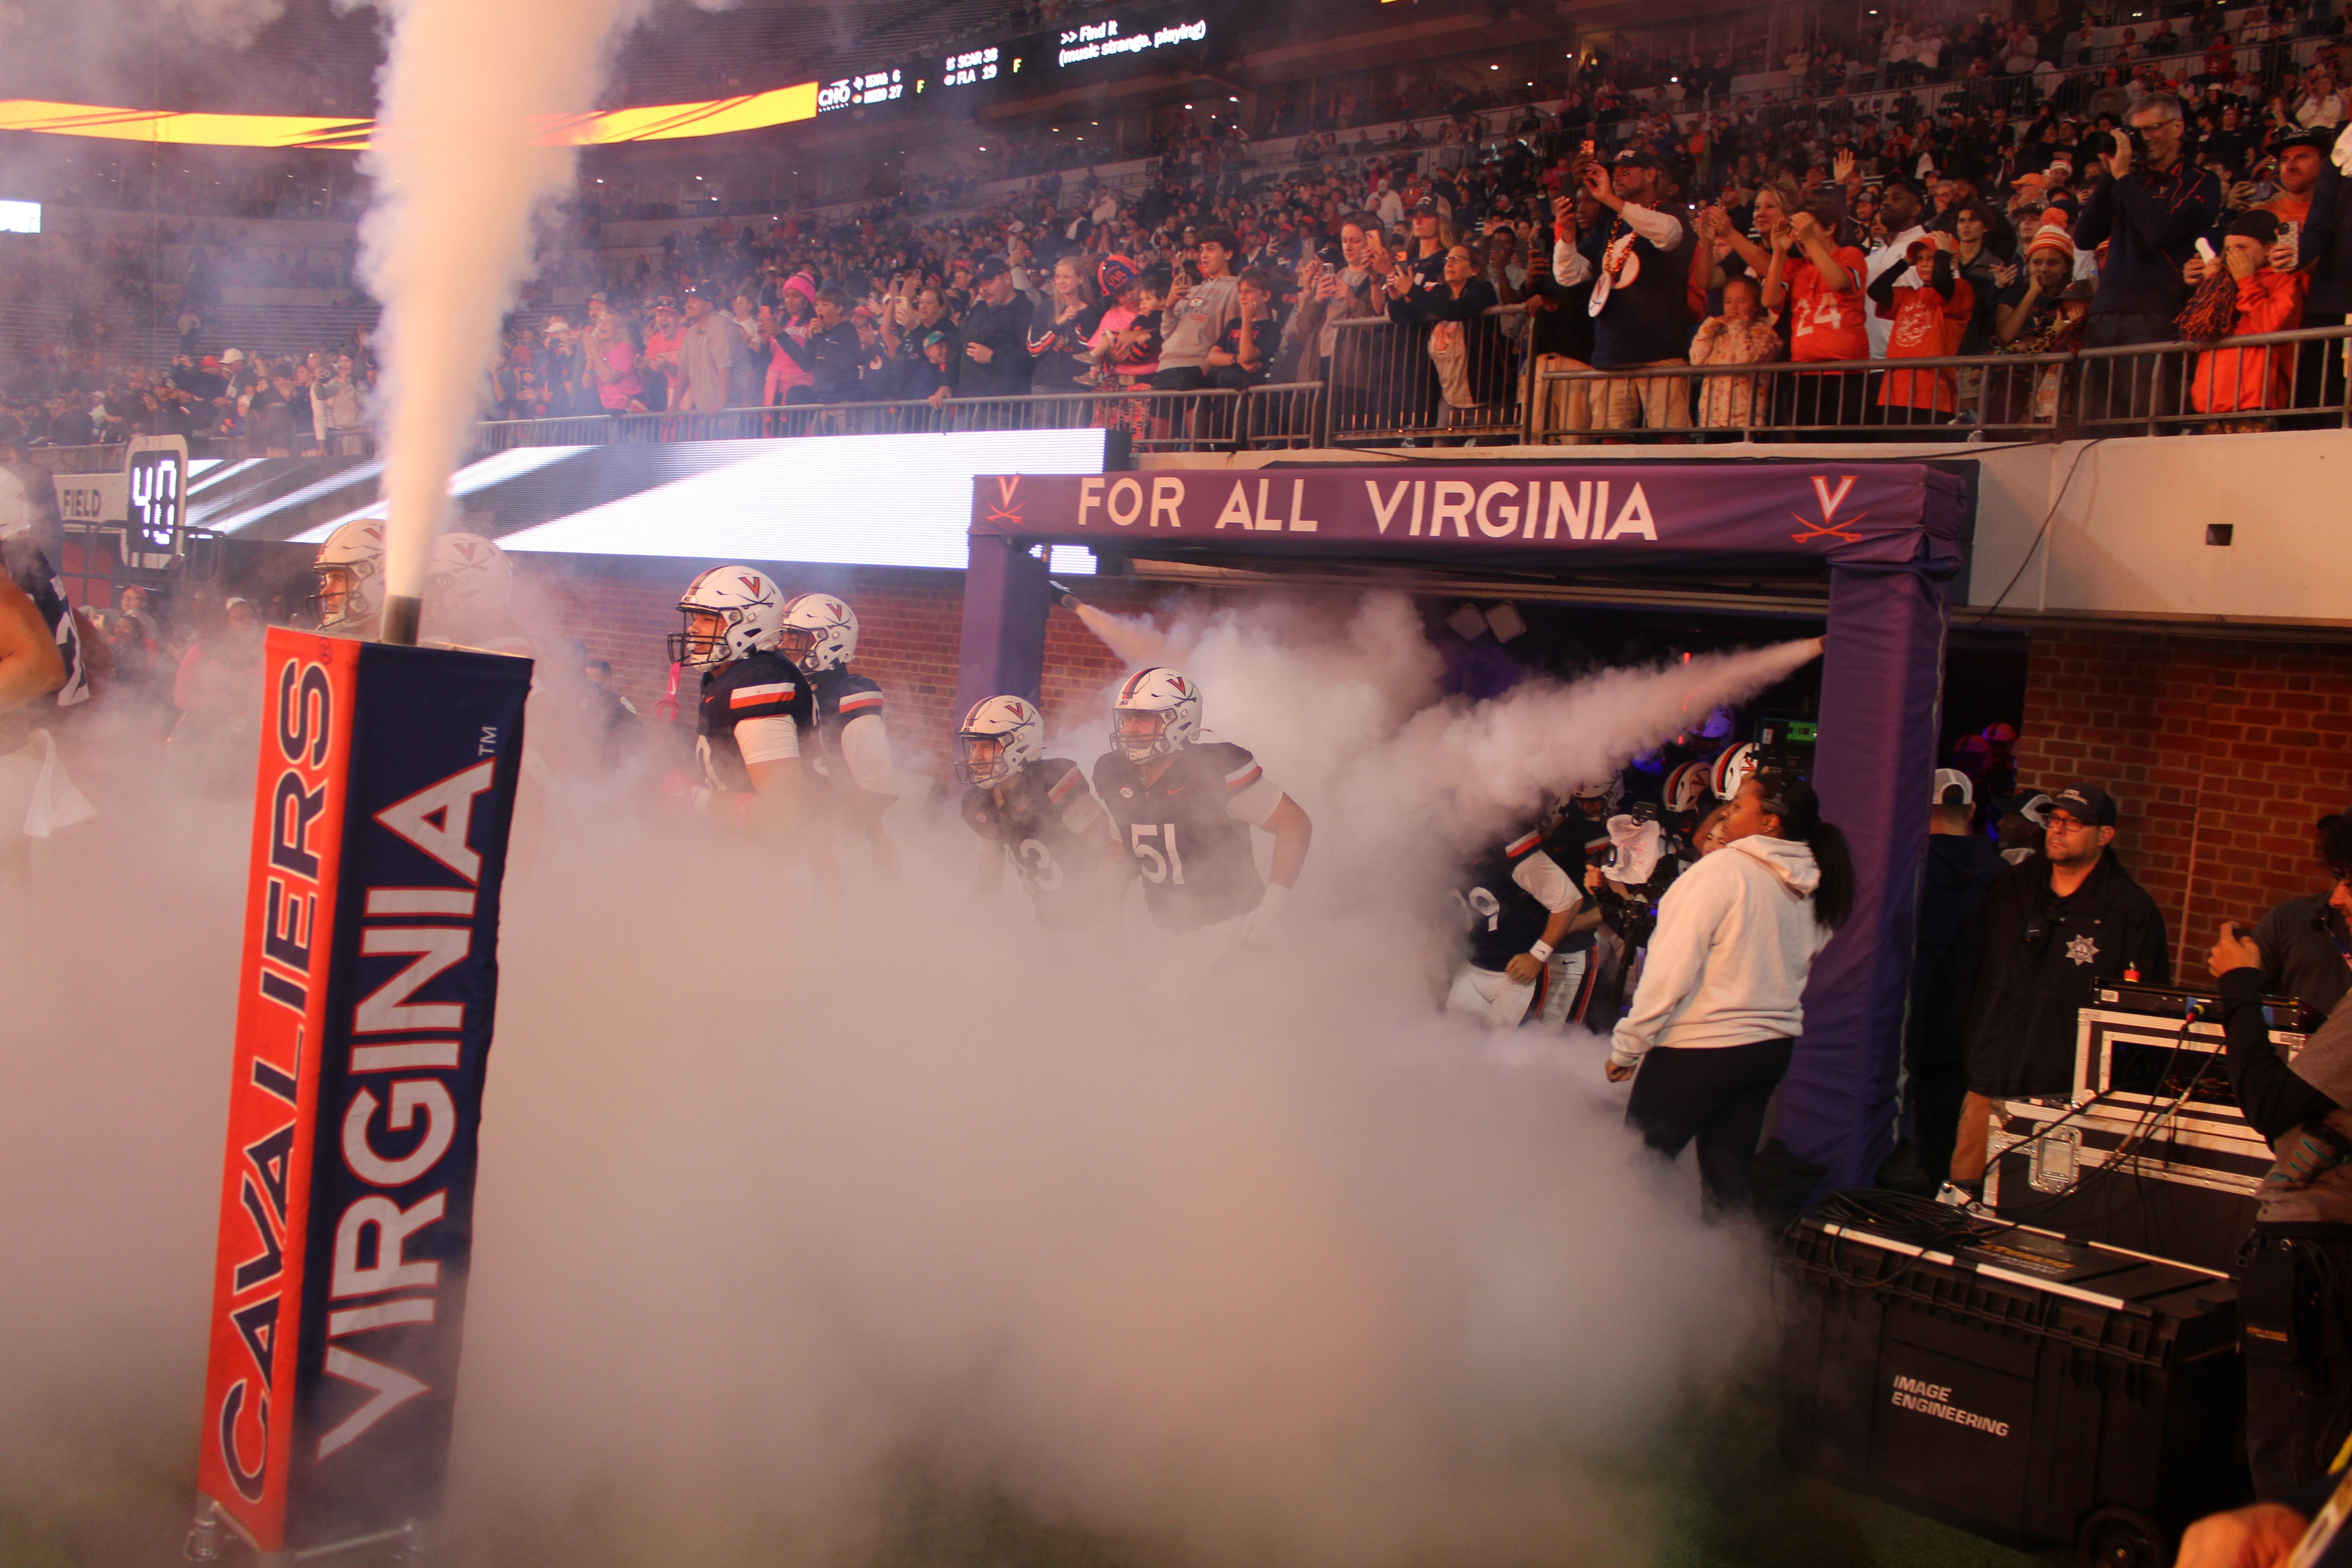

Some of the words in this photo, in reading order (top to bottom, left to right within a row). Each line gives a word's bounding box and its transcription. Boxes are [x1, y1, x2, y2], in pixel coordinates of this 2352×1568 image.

[1059, 42, 1100, 67] (music
[1154, 19, 1206, 48] playing)
[1080, 21, 1106, 42] Find
[1108, 20, 1118, 36] it
[957, 50, 982, 69] SCAR
[1012, 58, 1022, 73] F
[892, 68, 901, 83] 6
[916, 79, 925, 94] F
[956, 68, 976, 85] FLA
[982, 64, 997, 80] 19
[818, 85, 851, 107] CHO
[888, 84, 903, 100] 27
[1794, 292, 1842, 337] 24
[63, 489, 101, 517] FIELD
[1078, 477, 1185, 527] FOR
[1215, 479, 1318, 532] ALL
[1365, 480, 1658, 541] VIRGINIA
[1130, 823, 1185, 884] 51
[219, 657, 334, 1504] CAVALIERS
[317, 756, 497, 1463] VIRGINIA
[1893, 1374, 1951, 1403] IMAGE
[1891, 1391, 2010, 1437] ENGINEERING
